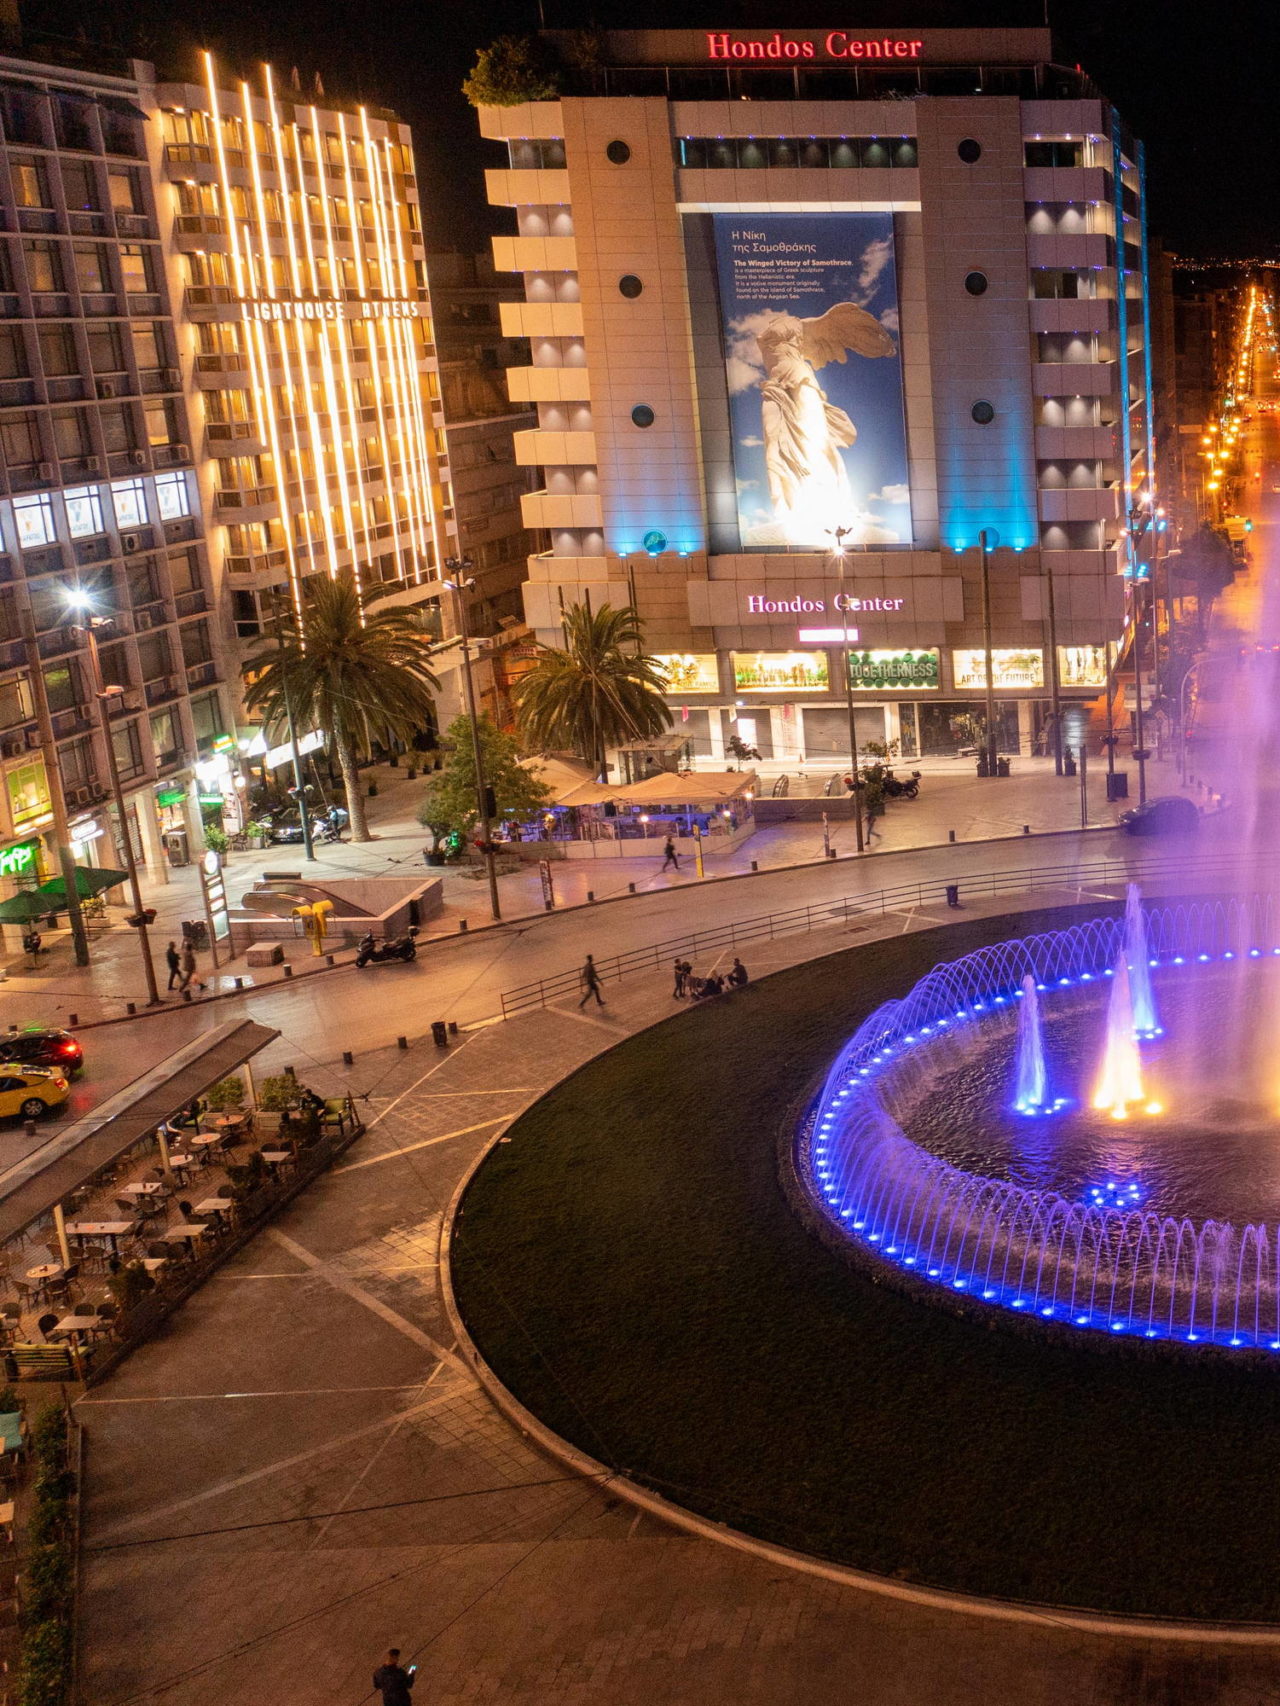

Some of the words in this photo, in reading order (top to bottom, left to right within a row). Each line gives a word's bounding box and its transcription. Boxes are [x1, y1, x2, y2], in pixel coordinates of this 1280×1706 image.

[706, 33, 814, 58] Hondos
[825, 32, 922, 57] Center
[731, 231, 739, 240] Η
[742, 230, 766, 241] Νίκη
[732, 244, 749, 253] της
[752, 242, 817, 253] Σαμοθράκης
[240, 302, 345, 320] LIGHTHOUSE
[362, 301, 419, 317] ATHENS
[747, 595, 825, 613] Hondos
[849, 662, 933, 679] TOGETHERNESS
[961, 674, 975, 684] ART
[1005, 673, 1035, 683] FUTURE
